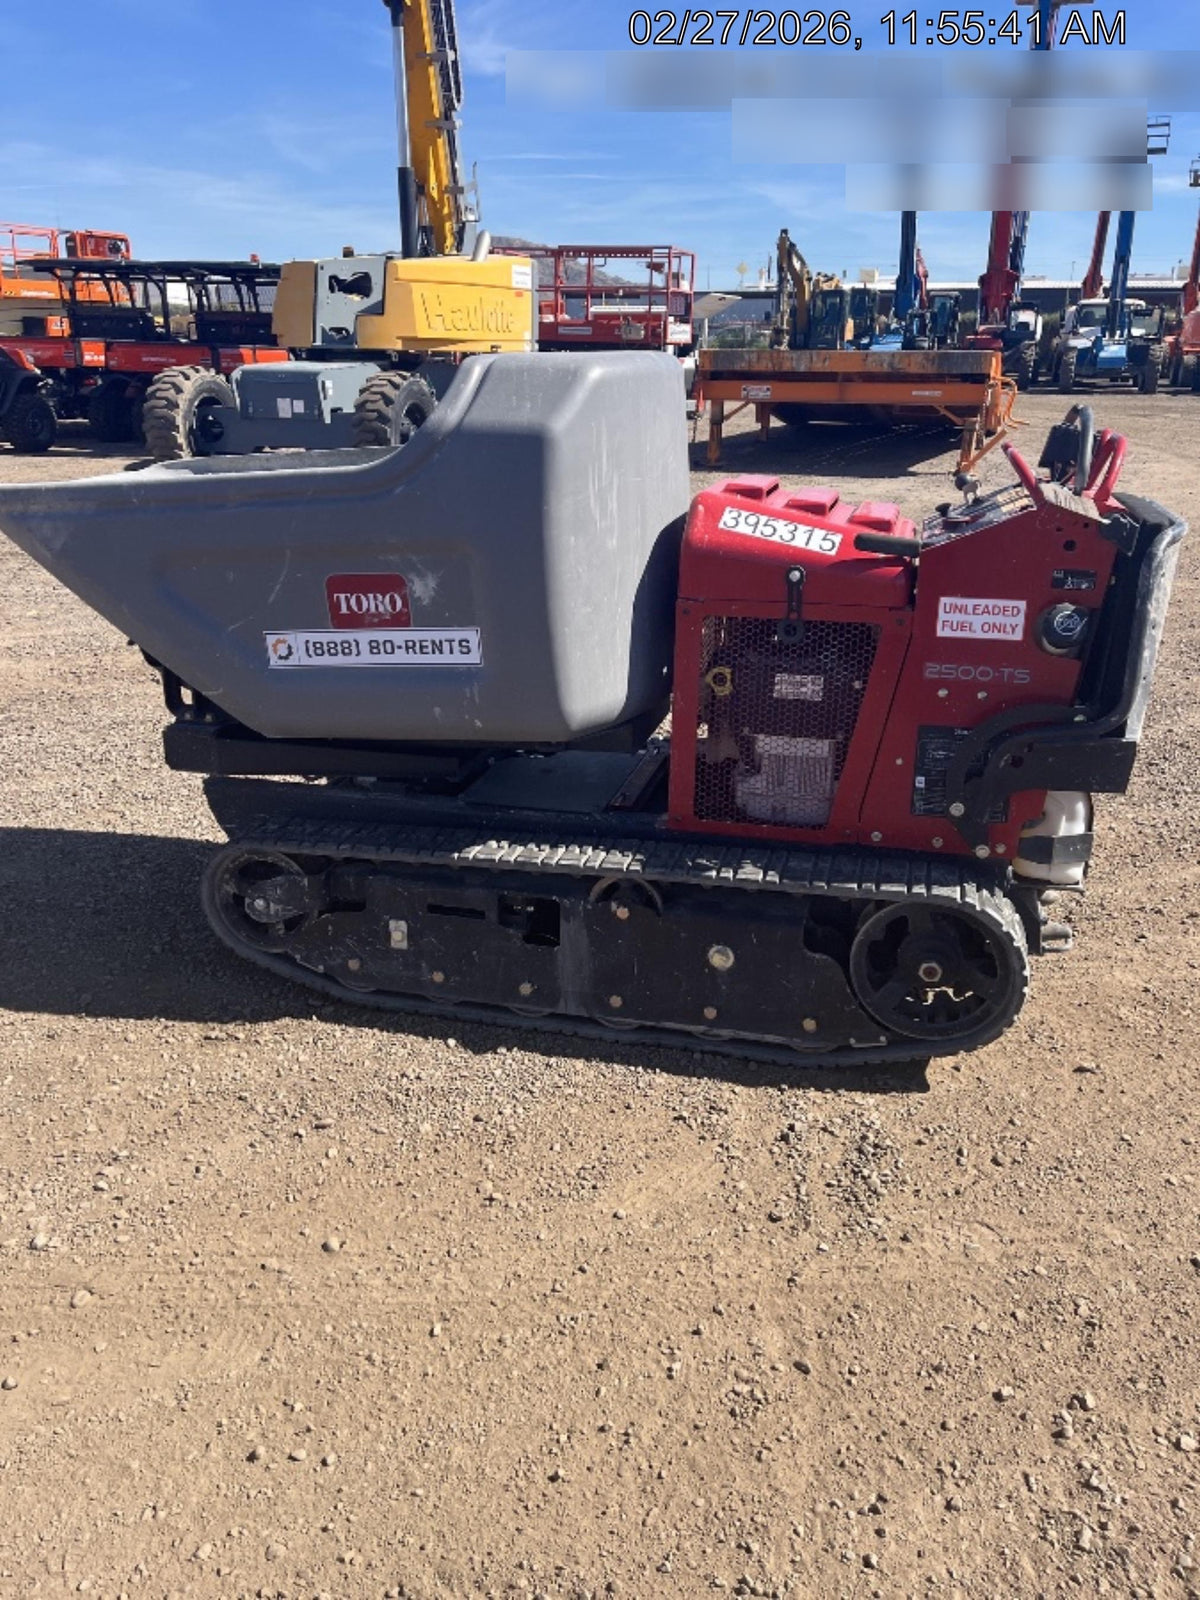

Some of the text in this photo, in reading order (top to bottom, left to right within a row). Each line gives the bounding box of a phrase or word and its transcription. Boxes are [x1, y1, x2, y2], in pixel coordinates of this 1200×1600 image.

[723, 508, 836, 553] 395315
[334, 592, 402, 614] TORO
[943, 602, 1020, 618] UNLEADED
[941, 620, 1019, 636] FUEL ONLY
[305, 638, 472, 657] (888) 80-RENTS
